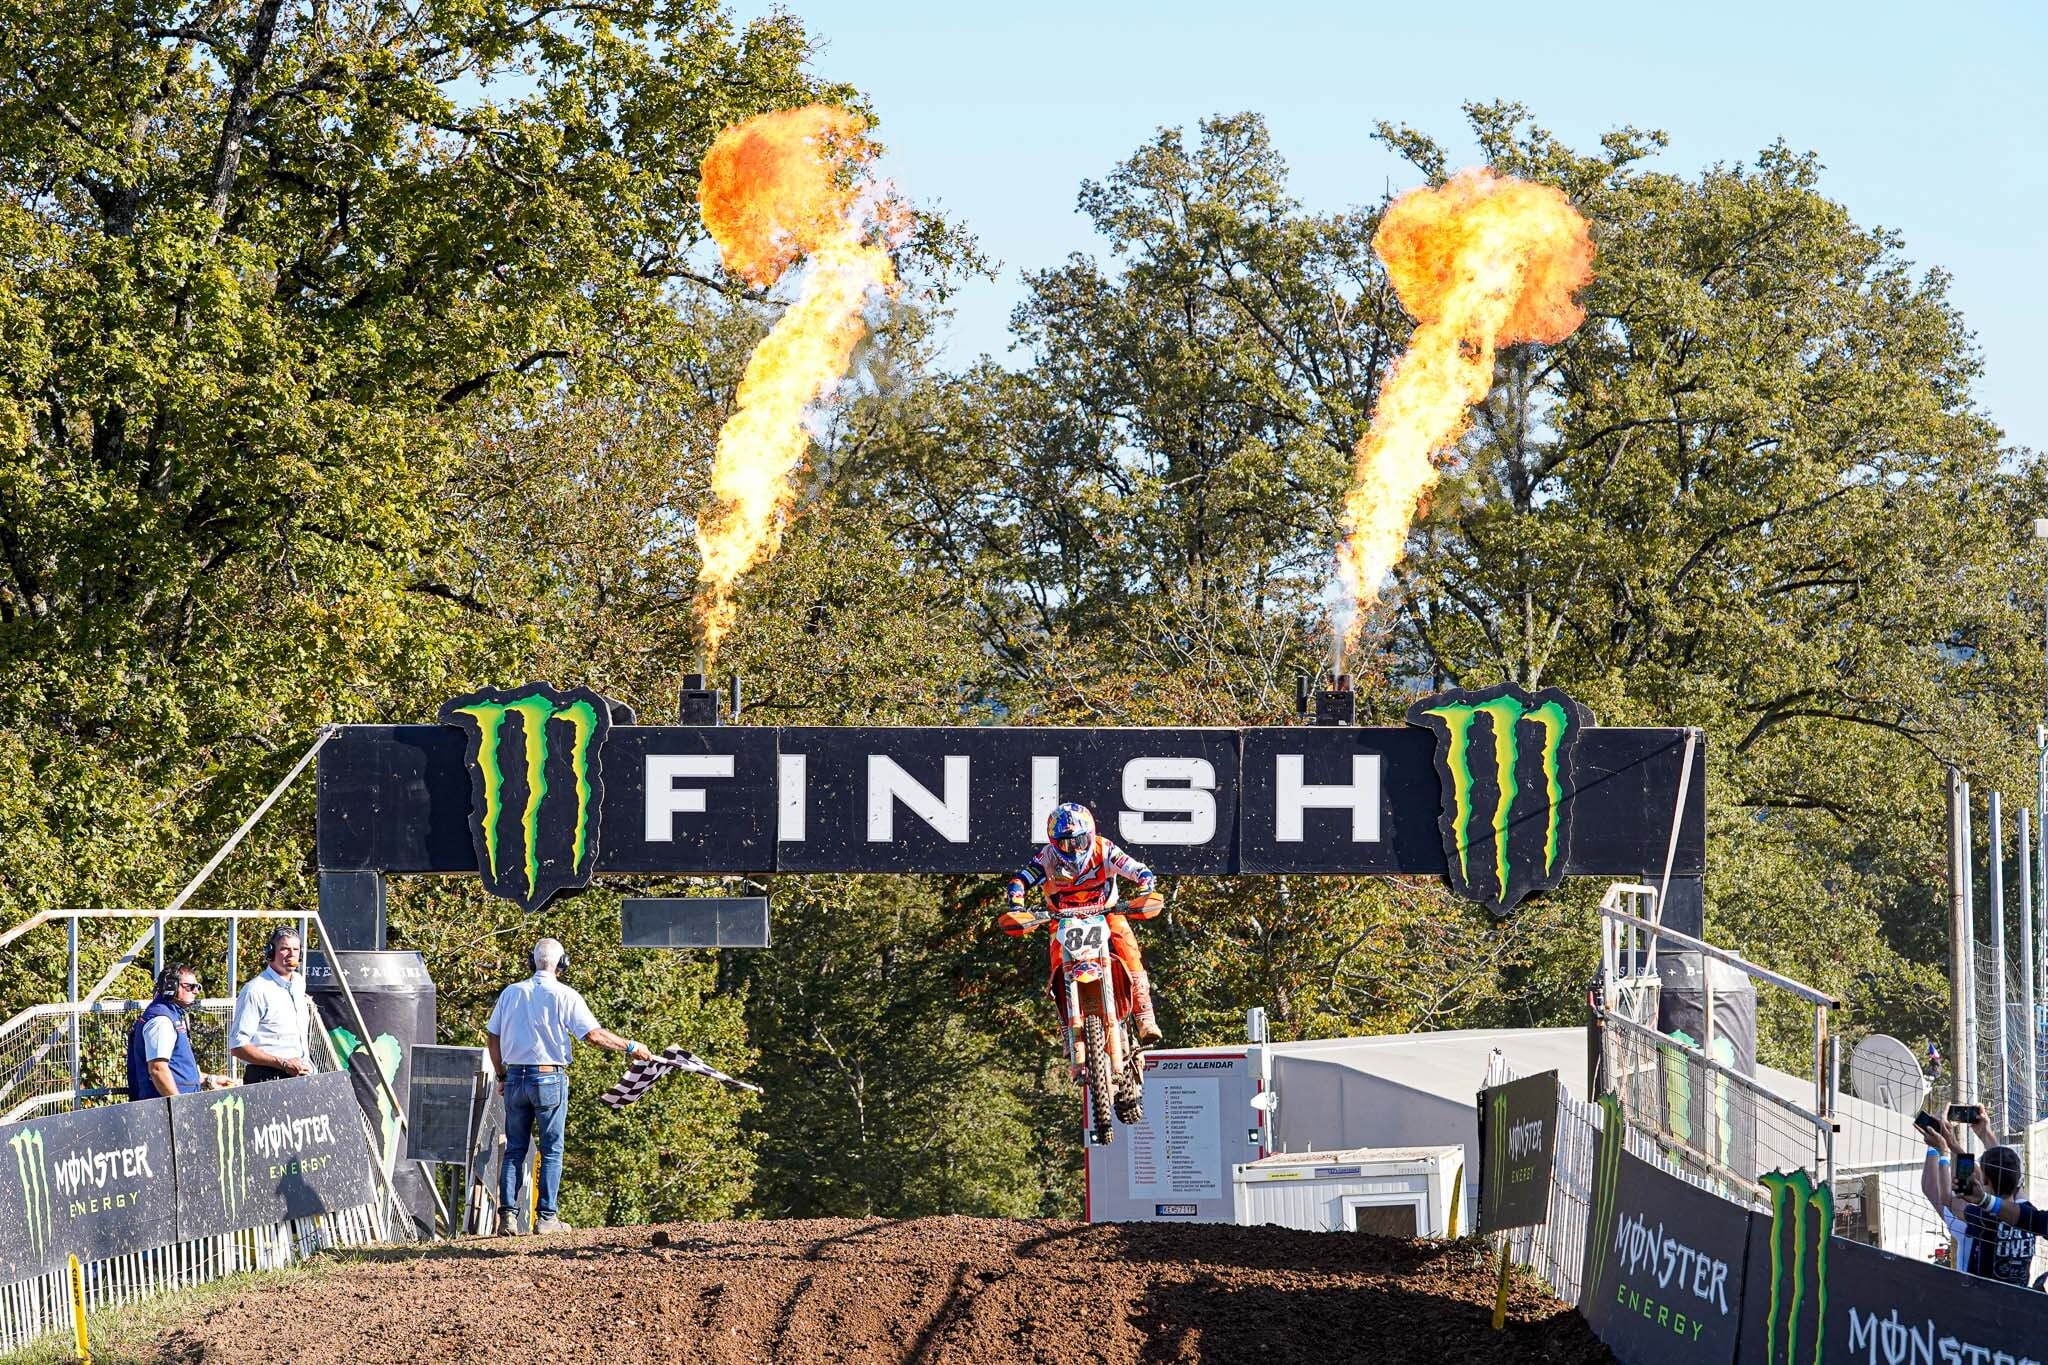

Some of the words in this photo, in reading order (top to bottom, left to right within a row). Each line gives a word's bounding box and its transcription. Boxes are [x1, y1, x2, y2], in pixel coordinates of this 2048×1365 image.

[645, 754, 1380, 844] FINISH
[1065, 926, 1102, 951] 84
[1162, 1062, 1183, 1070] 2021
[1187, 1061, 1234, 1069] CALENDAR
[270, 1156, 327, 1179] ENERGY
[1512, 1167, 1534, 1184] ENERGY
[70, 1191, 138, 1218] ENERGY
[1617, 1284, 1703, 1341] ENERGY
[1848, 1306, 2042, 1365] MONS
